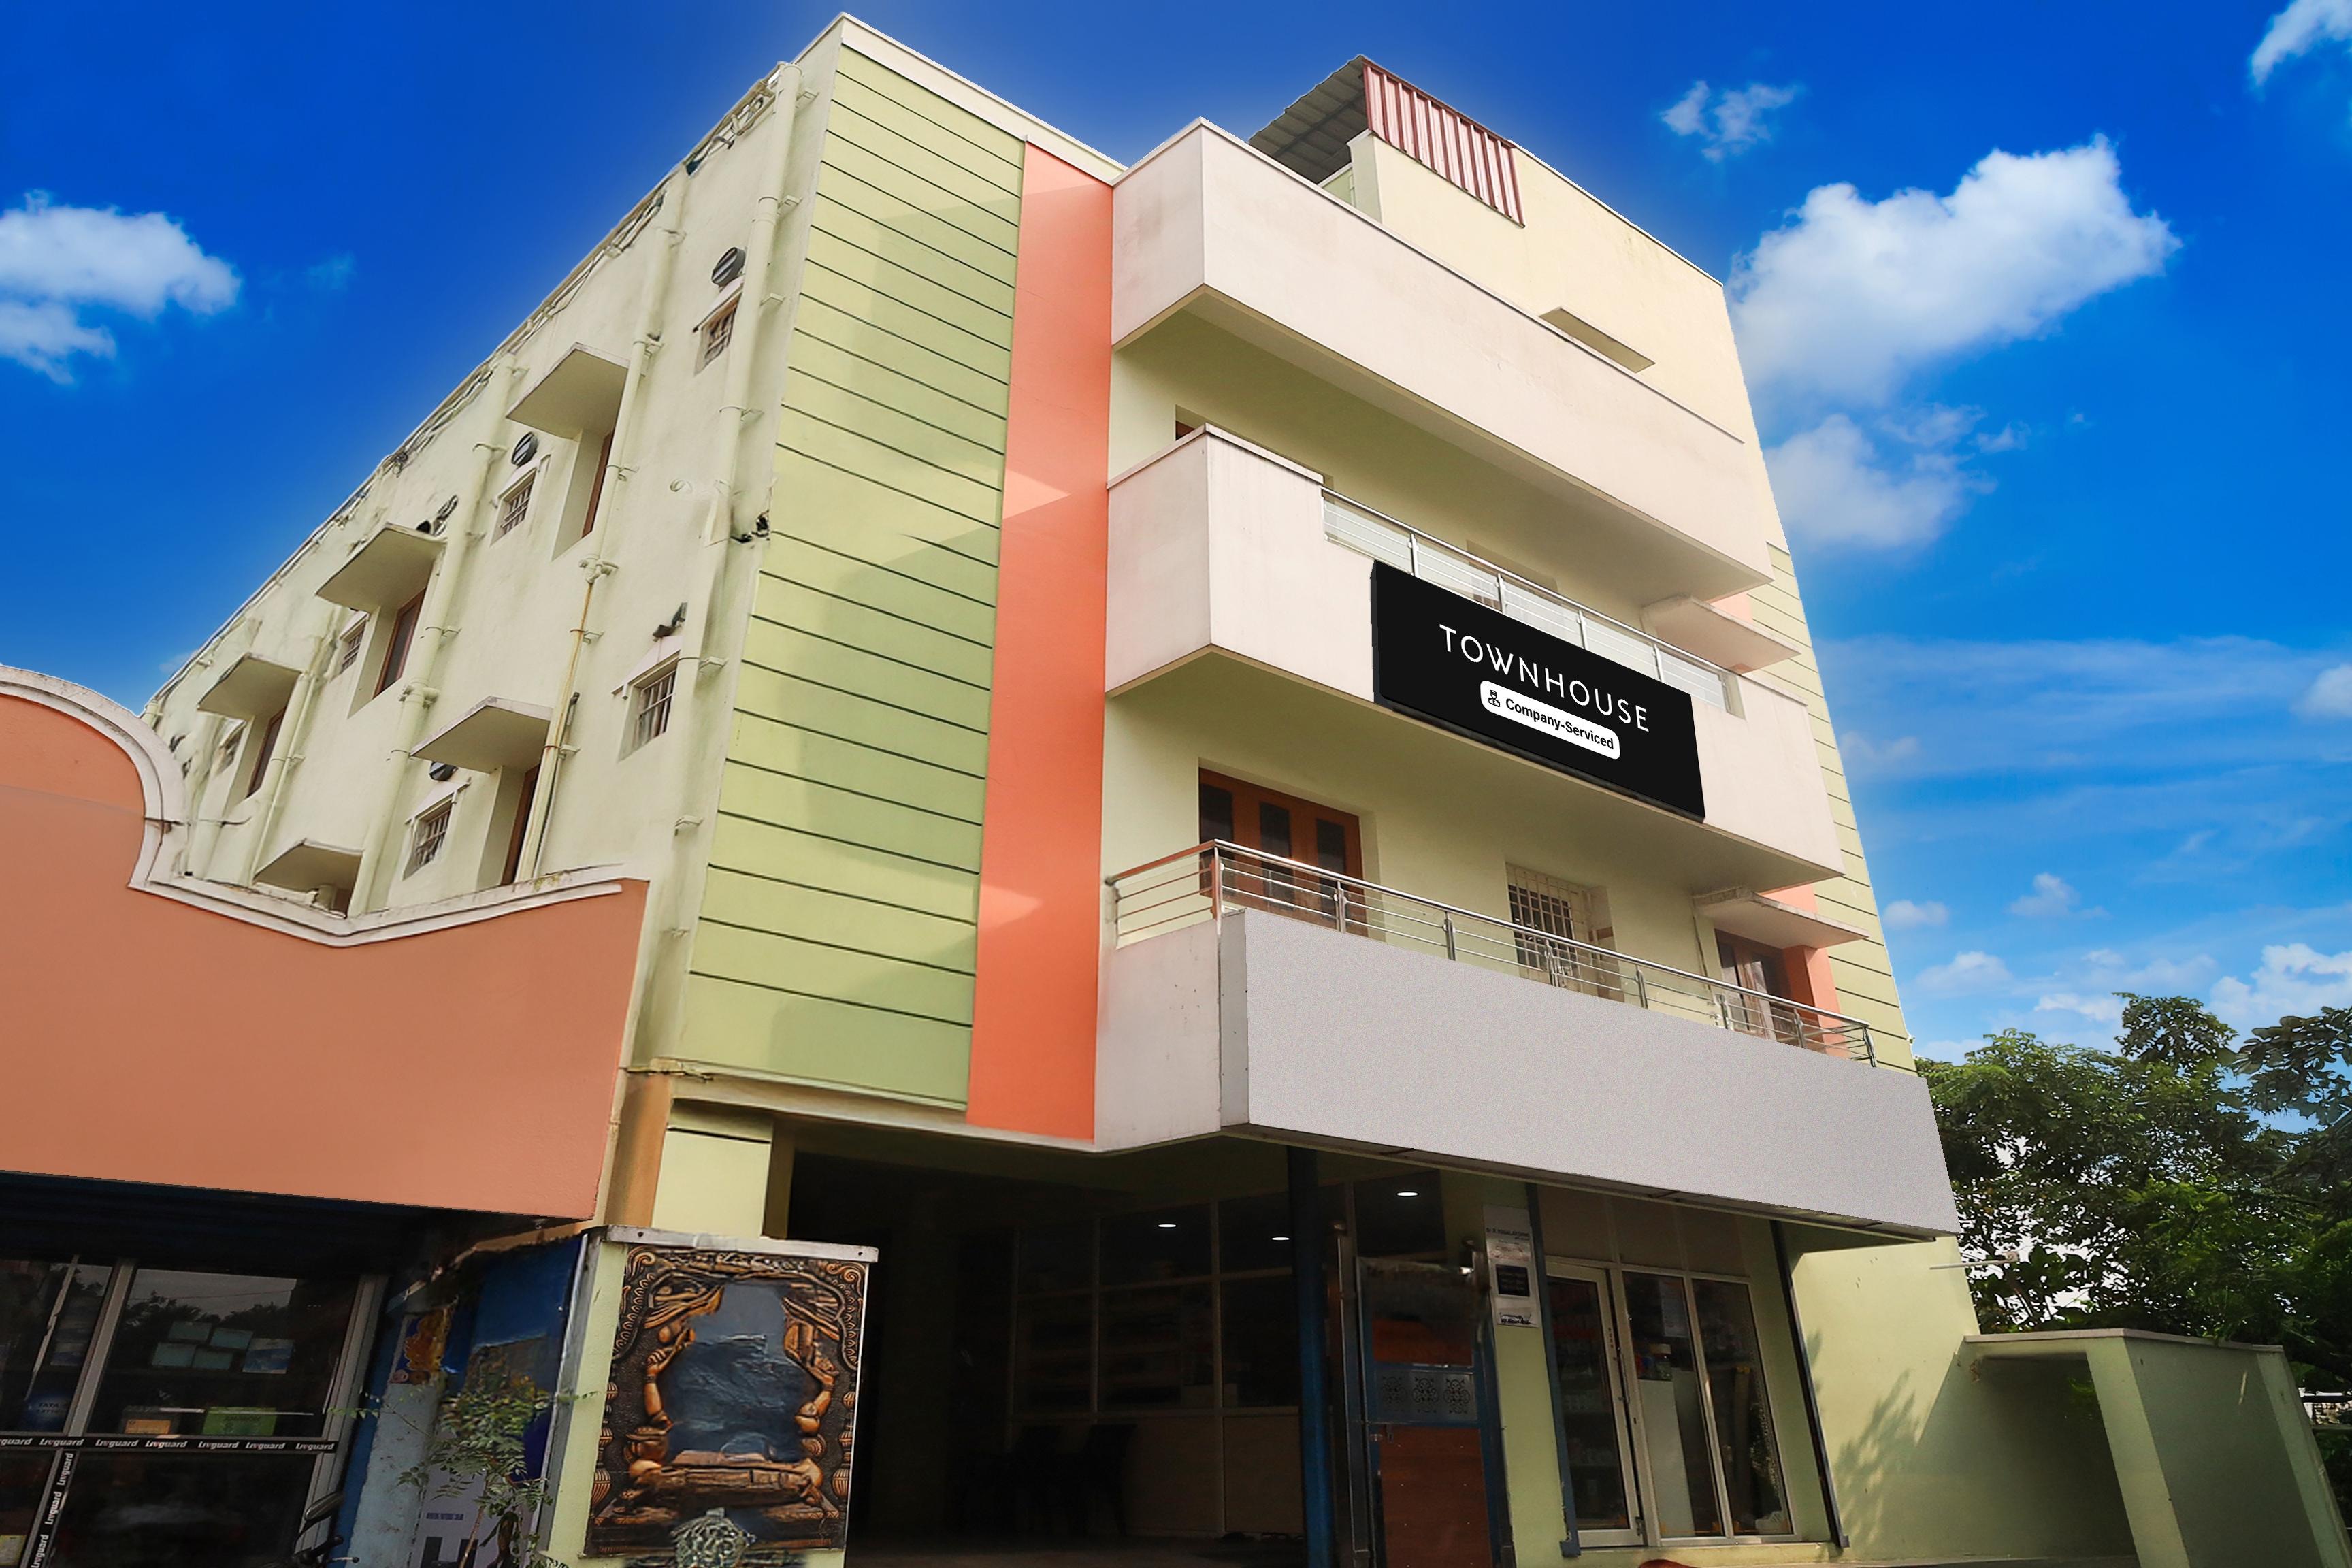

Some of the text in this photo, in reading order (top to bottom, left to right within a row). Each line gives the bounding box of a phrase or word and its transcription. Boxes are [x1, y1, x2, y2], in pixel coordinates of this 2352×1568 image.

[1439, 624, 1650, 732] TOWNHOUSE
[1505, 698, 1614, 749] Company-Serviced
[39, 1437, 85, 1447] Livguard
[95, 1439, 140, 1448] Livguard
[144, 1440, 189, 1449] Livguard
[197, 1441, 240, 1450] Livguard
[244, 1442, 286, 1451] Livguard
[295, 1443, 336, 1452] Livguard
[44, 1491, 62, 1525] Livguard
[56, 1452, 74, 1486] Livguard
